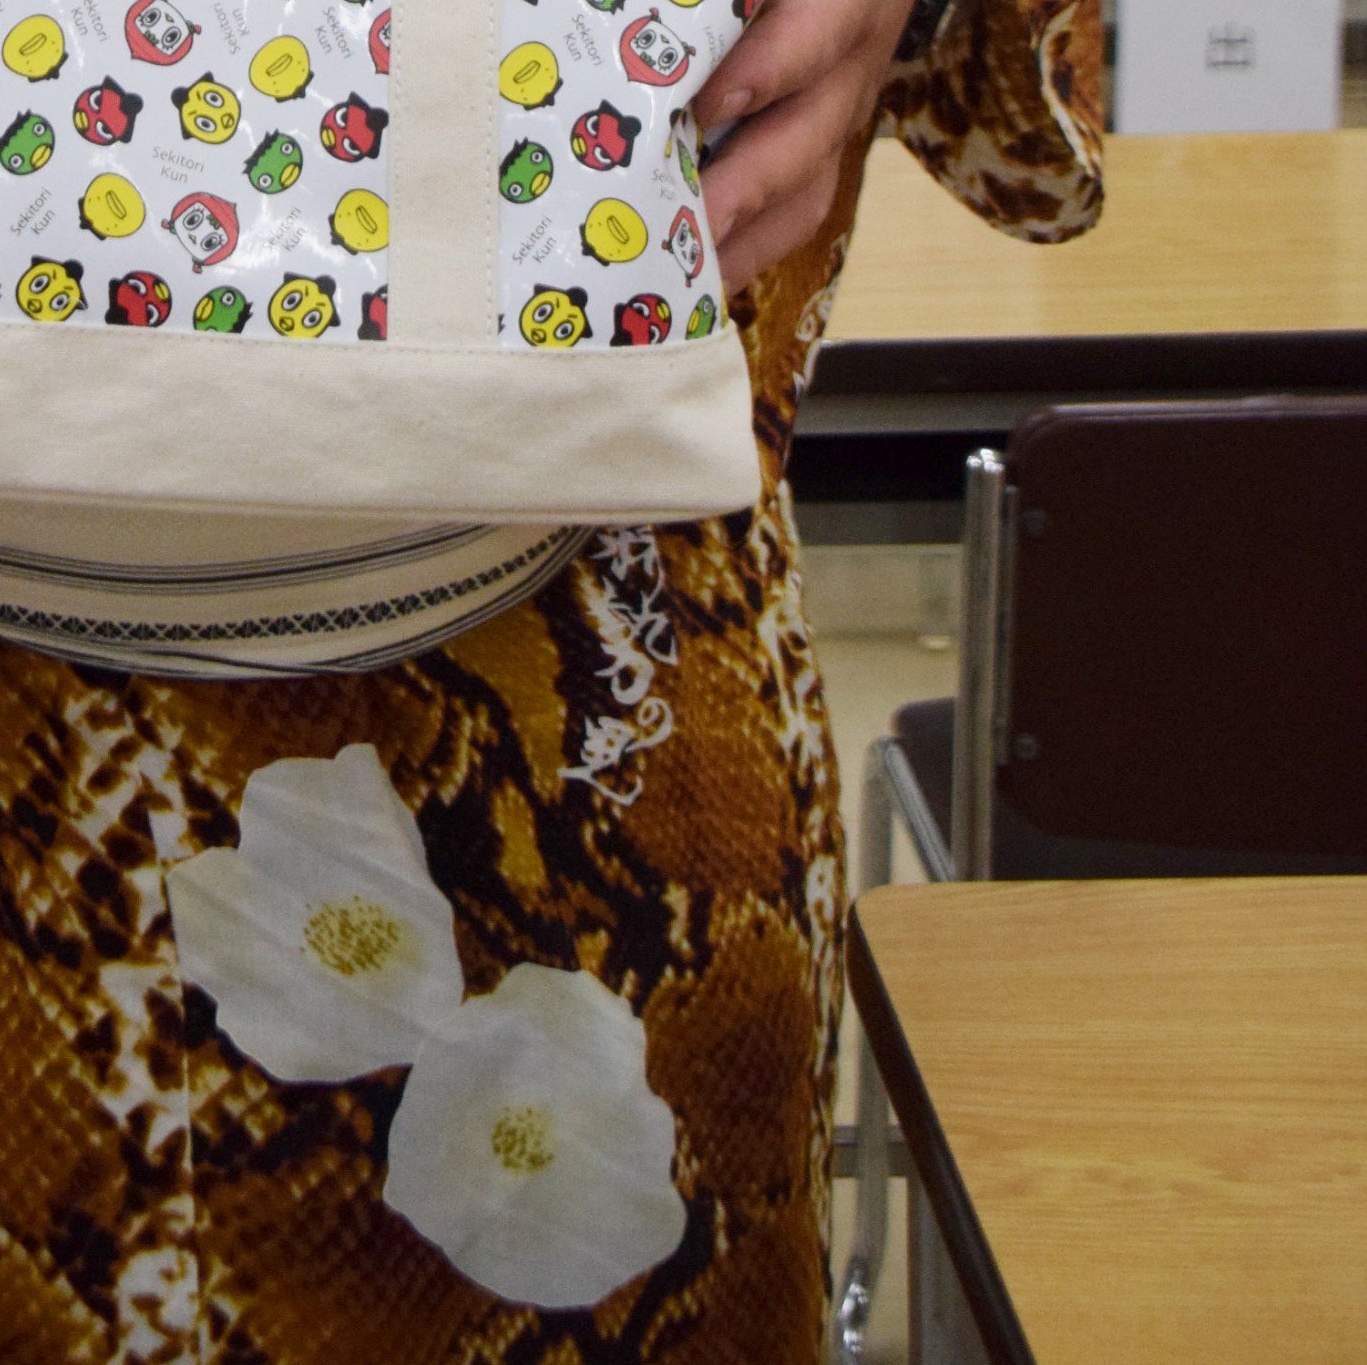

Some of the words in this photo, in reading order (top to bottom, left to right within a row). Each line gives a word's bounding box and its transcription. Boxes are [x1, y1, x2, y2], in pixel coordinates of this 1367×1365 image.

[70, 7, 88, 36] Kun
[212, 2, 240, 55] Sekitori
[232, 8, 250, 37] Kun
[322, 6, 355, 60] Sekitori
[314, 25, 332, 55] Kun
[563, 33, 583, 63] Kun
[571, 13, 603, 67] Sekitori
[151, 145, 205, 173] Sekitori
[160, 165, 189, 184] Kun
[9, 188, 52, 236] Sekitori
[32, 208, 56, 236] Kun
[284, 227, 307, 253] Kun
[511, 215, 552, 265] Sekitori
[533, 236, 557, 264] Kun
